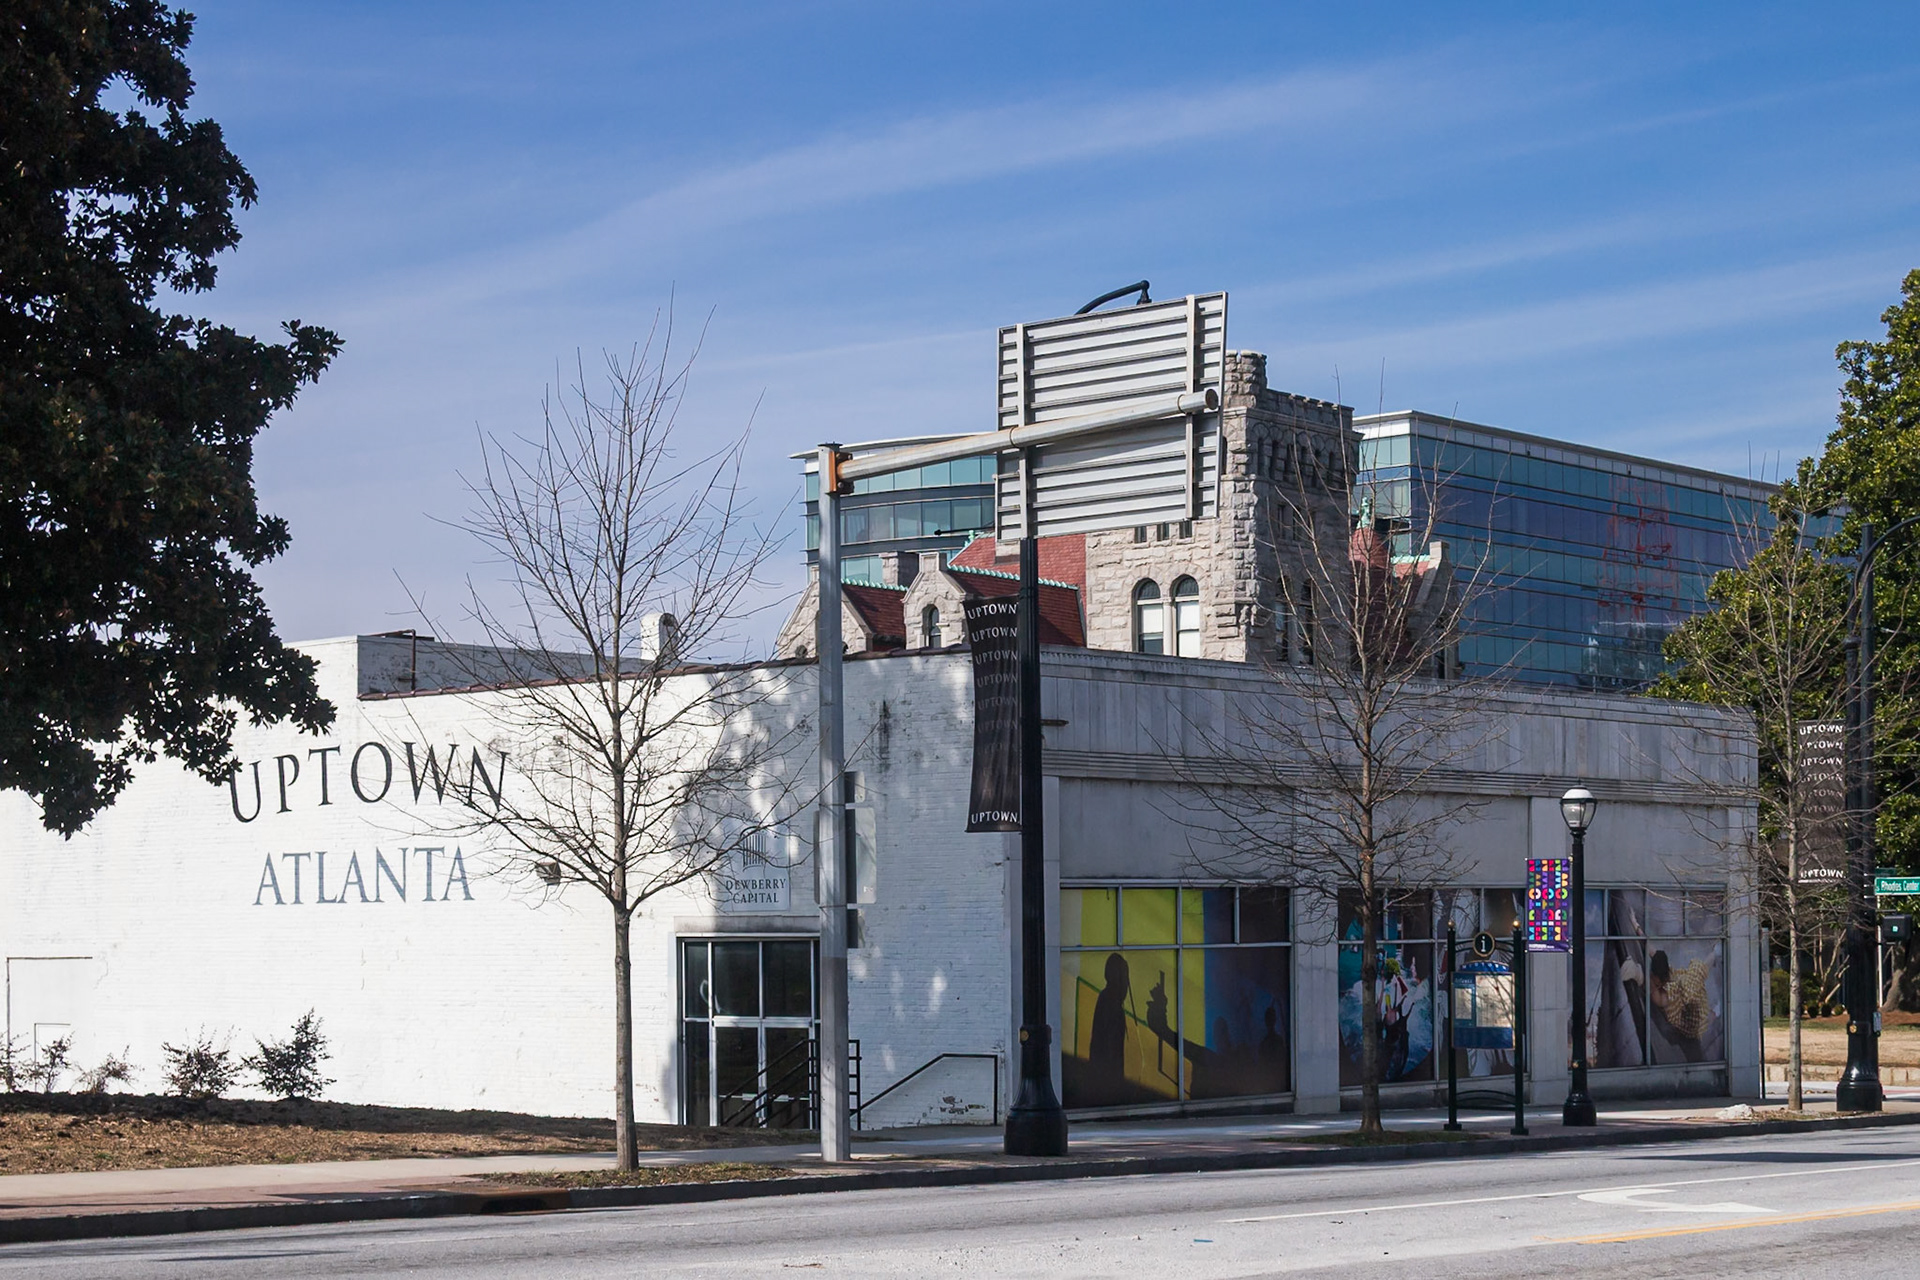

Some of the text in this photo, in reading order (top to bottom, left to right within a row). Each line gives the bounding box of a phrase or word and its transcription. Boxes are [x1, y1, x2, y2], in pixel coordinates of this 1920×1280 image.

[968, 603, 1017, 619] UPTOWN
[971, 626, 1018, 642] UPTOWN
[975, 650, 1018, 665] UPTOWN
[977, 673, 1018, 688] UPTOWN
[1799, 724, 1843, 735] UPTOWN
[229, 741, 511, 823] UPTOWN
[971, 810, 1018, 824] UPTOWN
[252, 846, 475, 905] ATLANTA
[1800, 869, 1844, 879] UPTOWN
[726, 879, 787, 891] DEWBERRY
[1881, 880, 1902, 891] Rhodes
[1903, 880, 1919, 891] Center
[732, 892, 779, 904] CAPITAL
